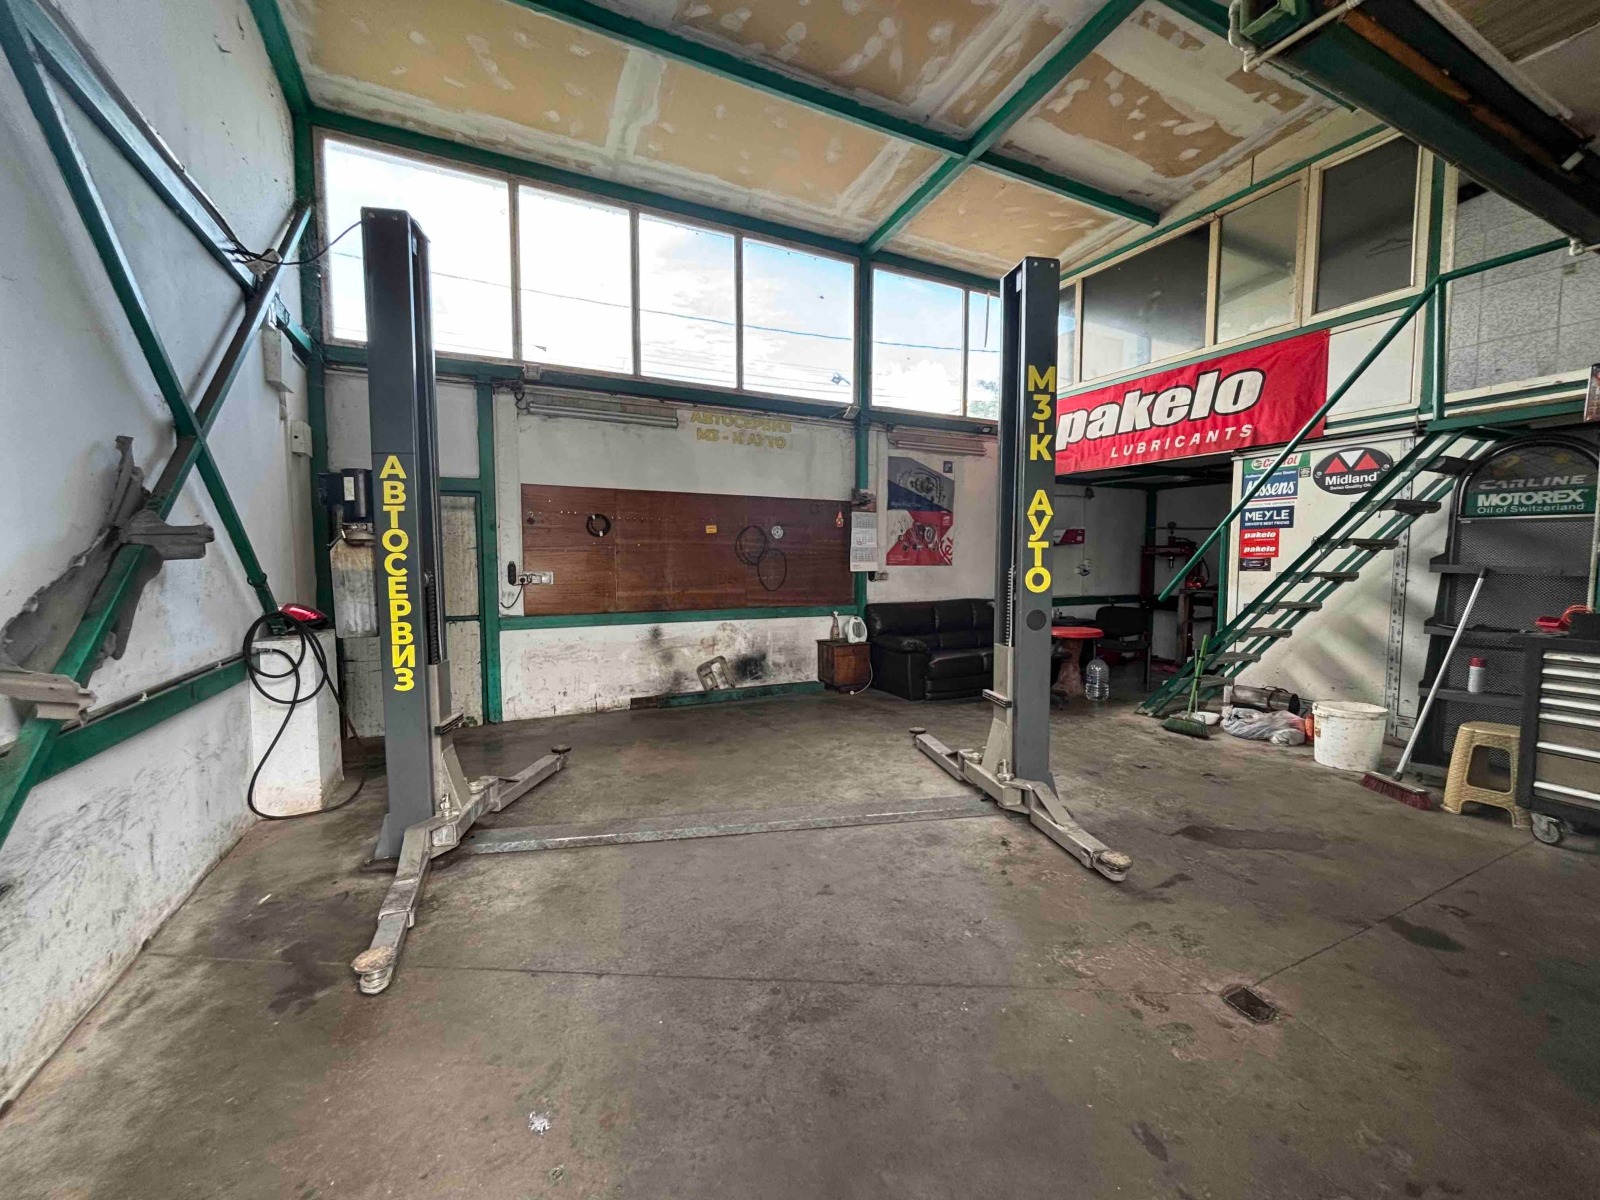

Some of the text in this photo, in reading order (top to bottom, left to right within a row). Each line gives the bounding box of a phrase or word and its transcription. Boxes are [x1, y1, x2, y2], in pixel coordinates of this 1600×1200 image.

[1055, 369, 1265, 451] pakelo
[1111, 424, 1253, 458] LUBRICANTS
[1325, 472, 1377, 486] Midland
[1477, 489, 1584, 507] MOTOREX
[1245, 509, 1290, 521] MEYLE
[1477, 503, 1585, 514] Oil of Switzerland
[1244, 531, 1277, 539] pakelo
[1243, 545, 1276, 554] pakelo
[379, 455, 416, 691] АВТОСЕРВИЗ
